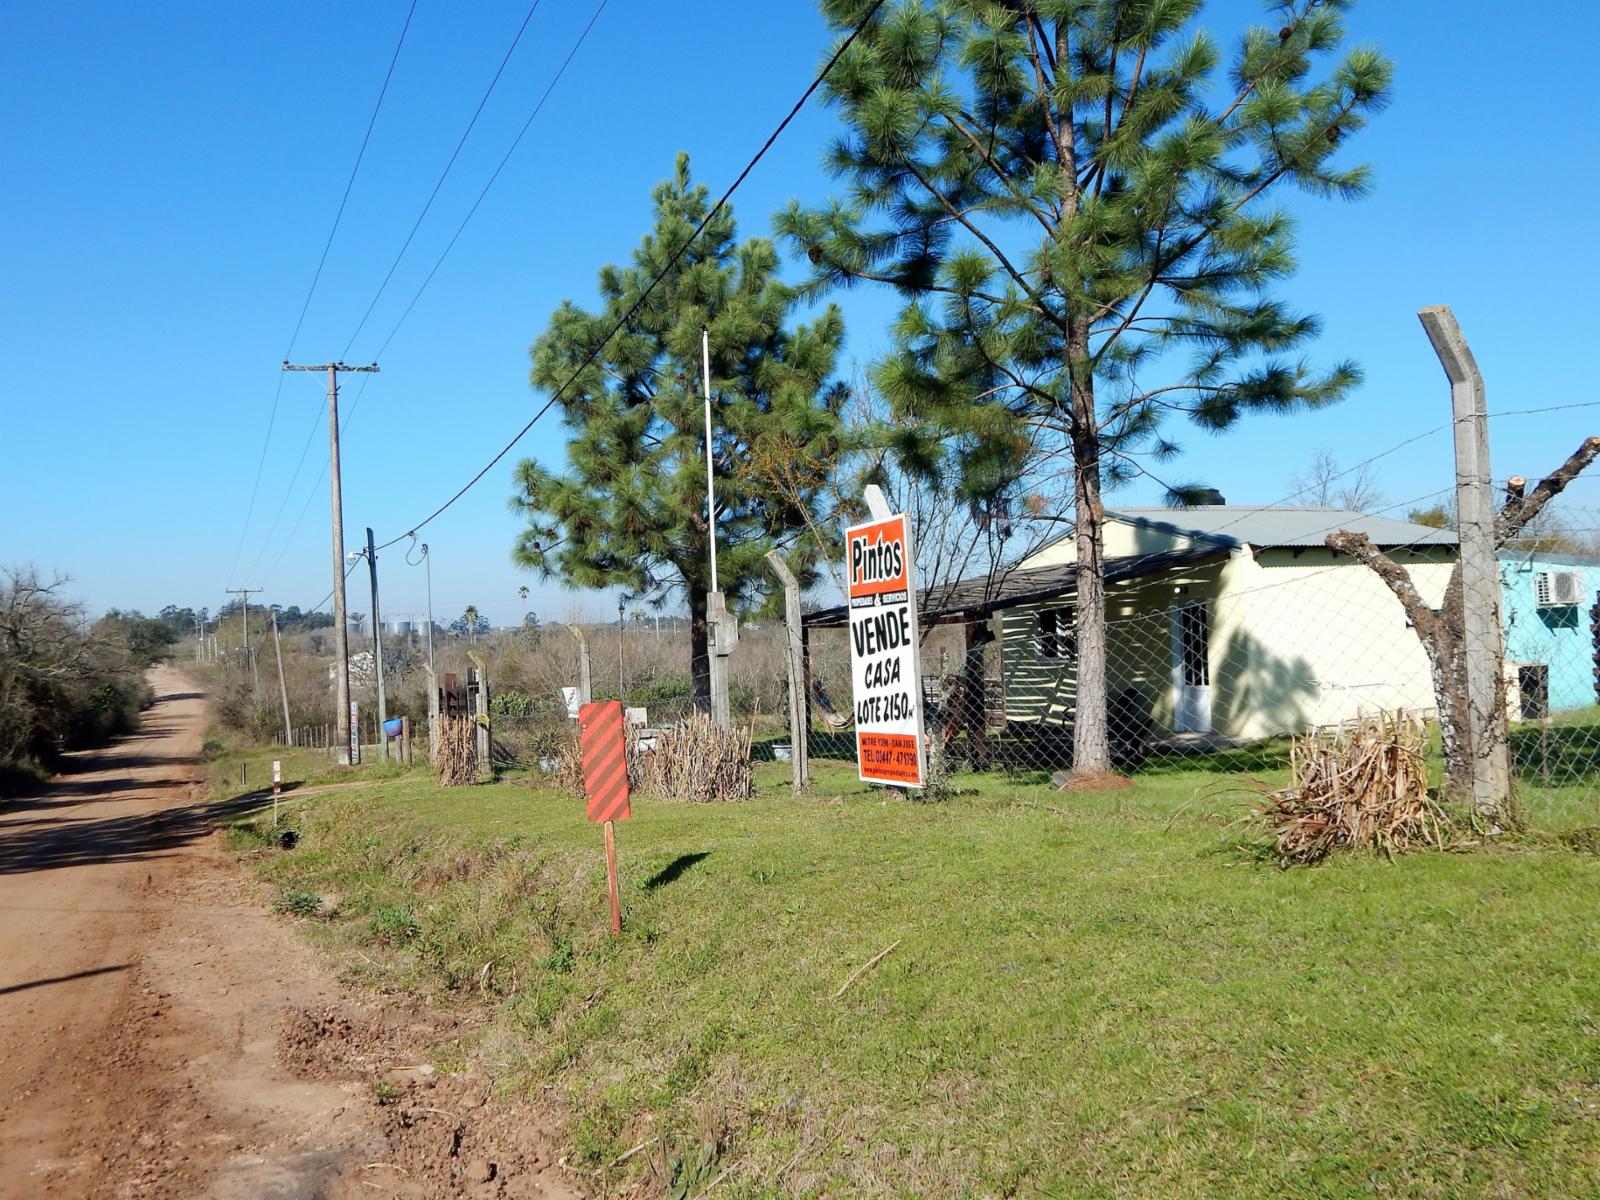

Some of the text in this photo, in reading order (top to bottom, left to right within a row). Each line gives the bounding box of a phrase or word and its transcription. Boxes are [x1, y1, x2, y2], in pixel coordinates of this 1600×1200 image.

[853, 536, 902, 583] Pintos
[852, 606, 910, 658] VENDE
[864, 656, 901, 689] CASA
[857, 697, 881, 725] LOTE
[883, 692, 908, 723] 2150
